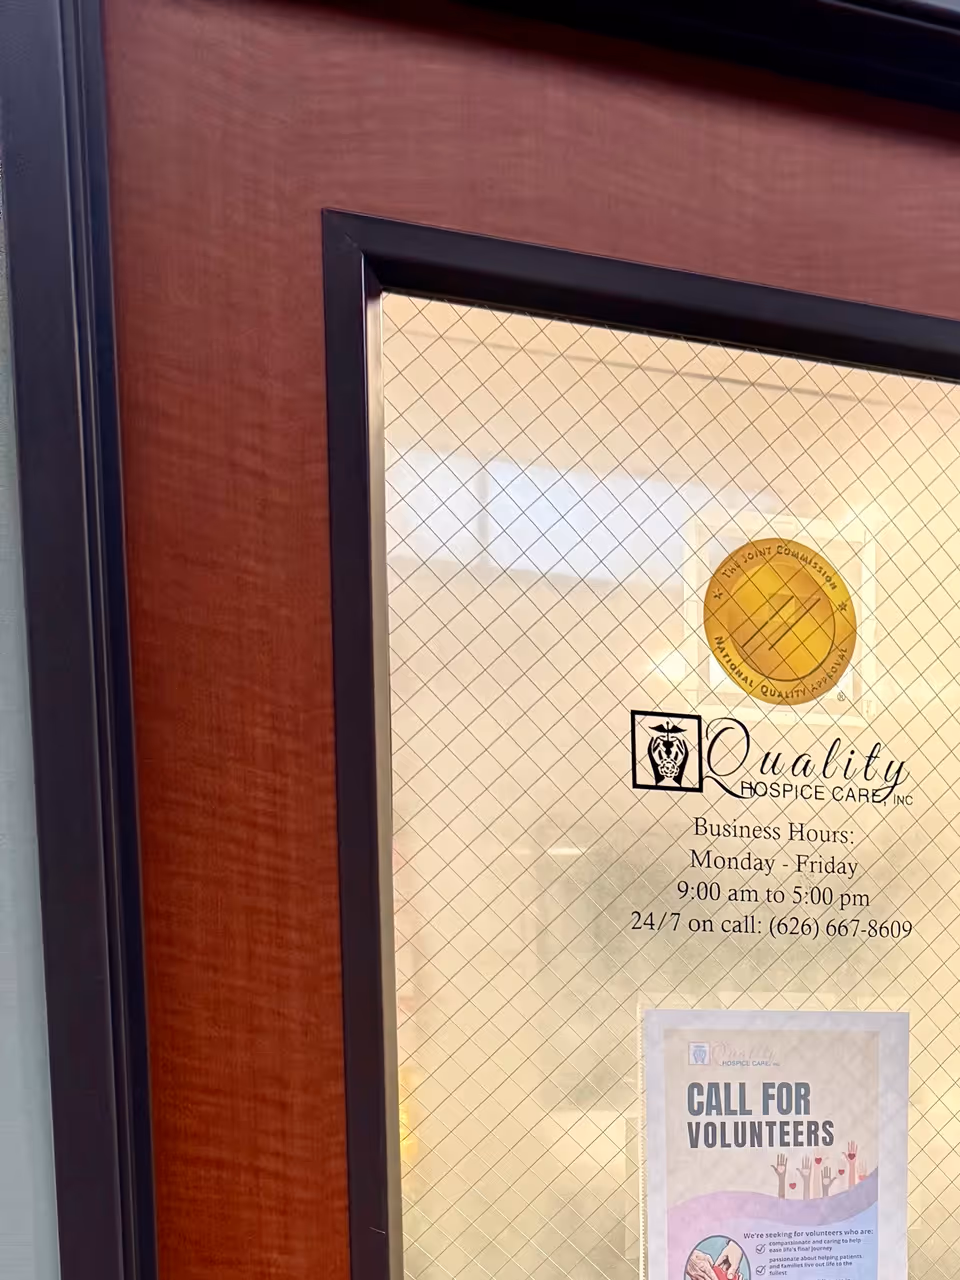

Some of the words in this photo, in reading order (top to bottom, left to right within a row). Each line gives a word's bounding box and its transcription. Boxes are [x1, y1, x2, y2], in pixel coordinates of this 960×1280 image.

[721, 561, 741, 579] THE
[743, 546, 772, 564] JOINT
[776, 545, 838, 590] COMMISSION
[714, 635, 754, 688] NATIONAL
[760, 684, 806, 699] QUALITY
[810, 647, 848, 692] APPROVAL
[702, 717, 910, 804] Quality
[740, 781, 825, 801] HOSPICE
[831, 786, 887, 807] CARE,
[893, 793, 914, 806] INC
[693, 816, 781, 841] Business
[787, 821, 855, 845] Hours:
[689, 849, 776, 877] Monday
[795, 854, 859, 879] Friday
[677, 880, 721, 901] 9:00
[727, 887, 759, 903] am
[766, 888, 785, 903] to
[792, 885, 833, 906] 5:00
[839, 891, 871, 911] pm
[630, 910, 681, 932] 24/7
[688, 917, 714, 933] on
[720, 915, 762, 934] call:
[769, 916, 820, 940] (626)
[825, 918, 913, 939] 667-8609
[721, 1059, 751, 1067] HOSPICE
[687, 1082, 753, 1116] CALL
[762, 1082, 811, 1116] FOR
[687, 1120, 835, 1149] VOLUNTEERS
[765, 1231, 793, 1239] seeking
[805, 1229, 843, 1237] volunteers
